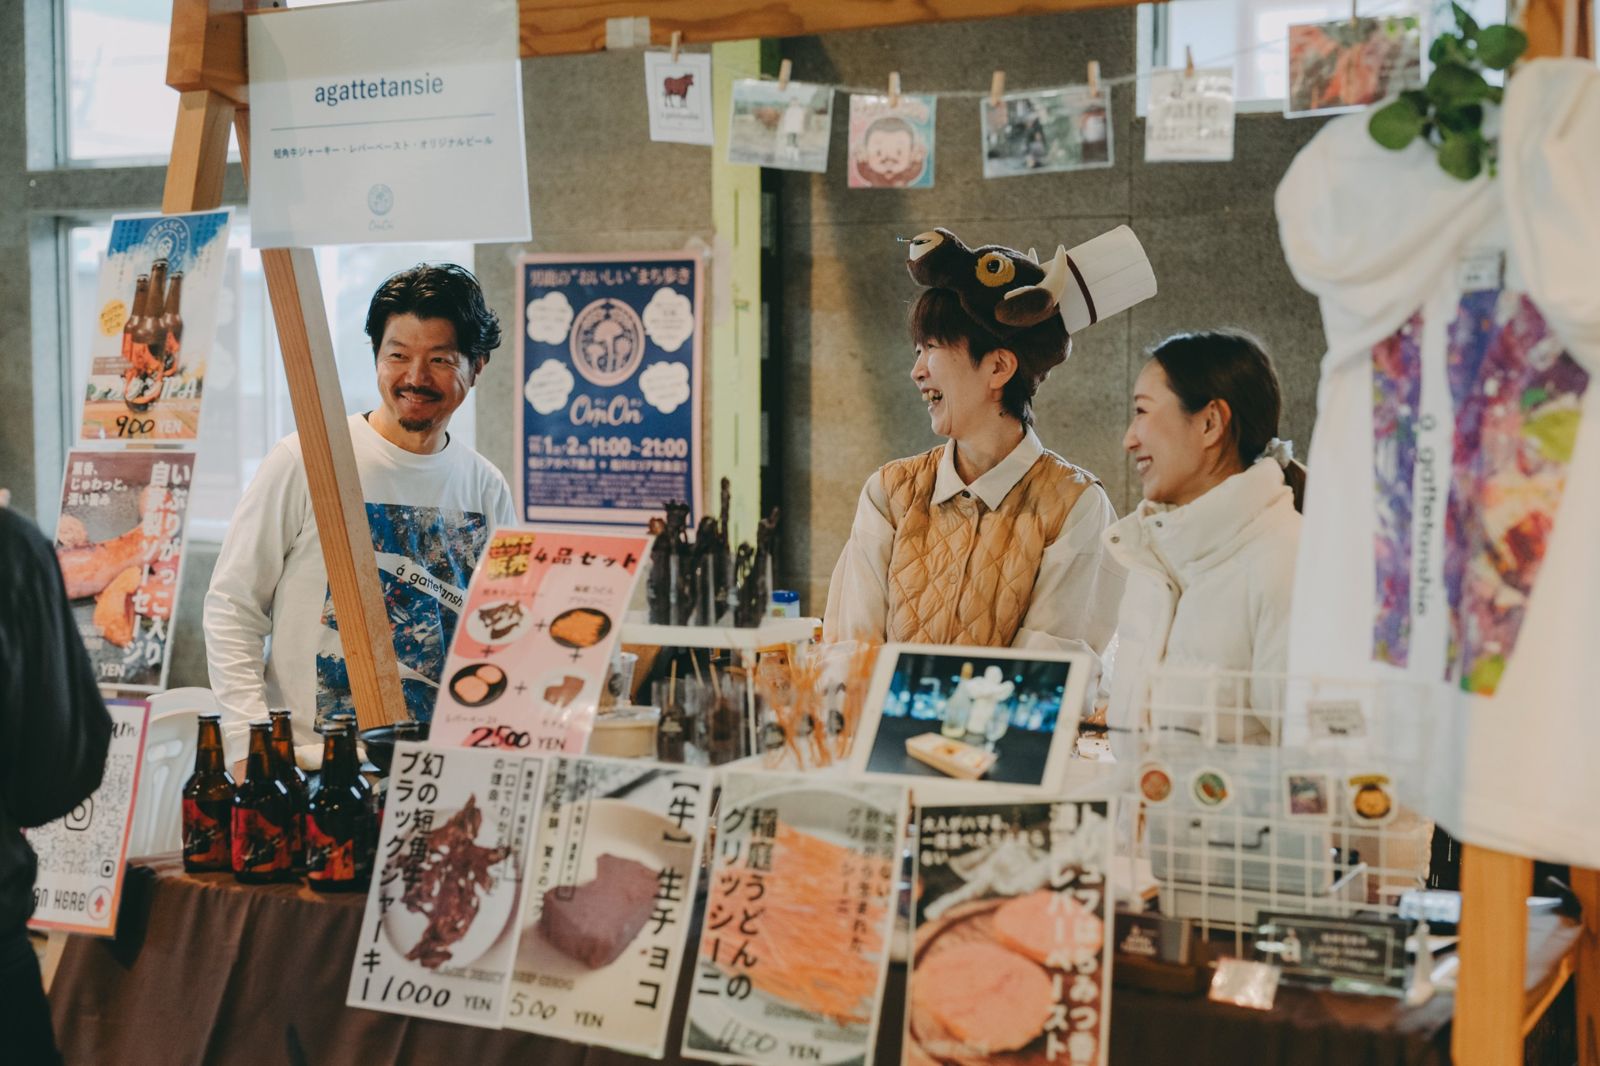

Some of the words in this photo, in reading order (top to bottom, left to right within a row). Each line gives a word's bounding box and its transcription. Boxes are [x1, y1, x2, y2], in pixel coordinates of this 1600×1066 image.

[315, 72, 443, 106] agattetansie
[116, 415, 155, 438] 900
[410, 573, 464, 608] gattetansh
[100, 662, 125, 678] YEN
[471, 725, 531, 748] 2500
[538, 737, 567, 750] YEN
[361, 751, 422, 1000] ブラックジャーキー
[698, 806, 749, 996] グリッシーニ
[727, 807, 778, 1001] 稲庭うどんの
[464, 994, 492, 1011] YEN
[509, 992, 557, 1019] 500
[574, 1009, 604, 1028] YEN
